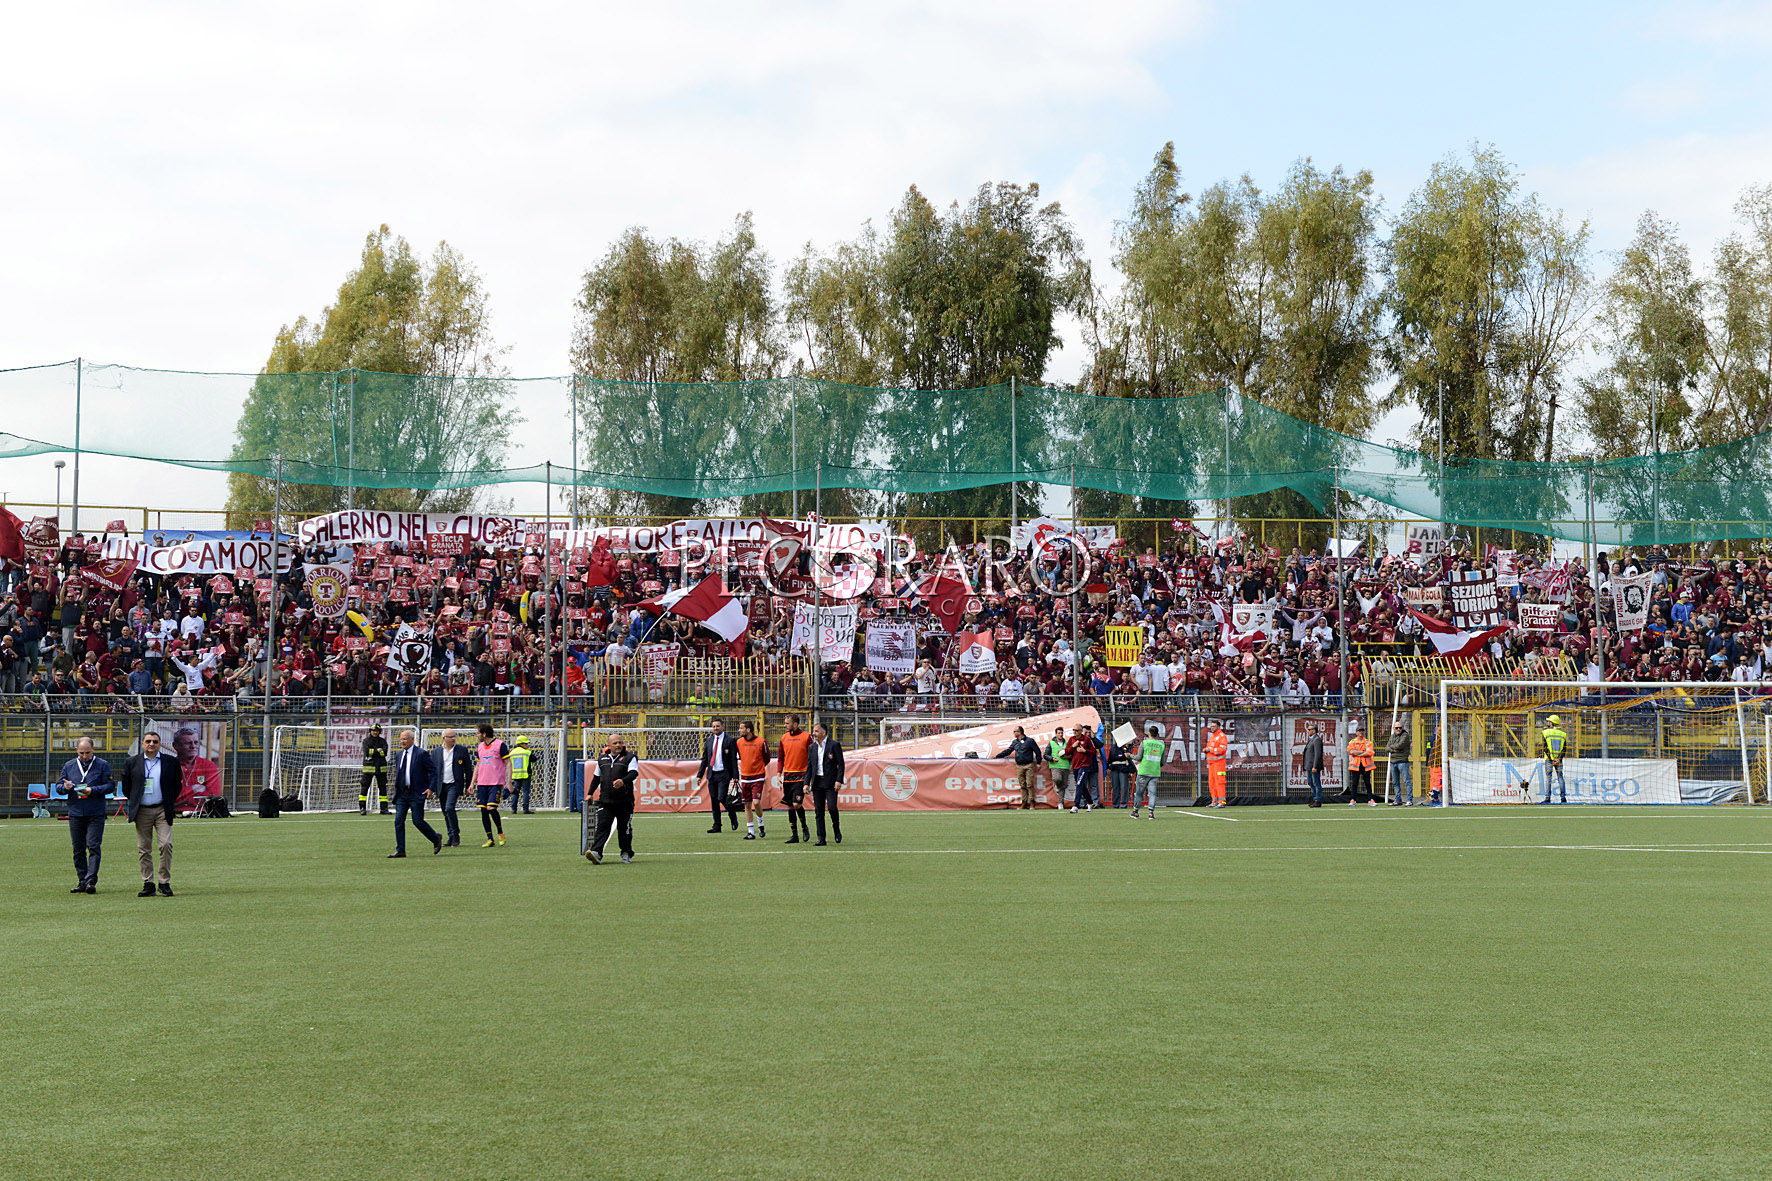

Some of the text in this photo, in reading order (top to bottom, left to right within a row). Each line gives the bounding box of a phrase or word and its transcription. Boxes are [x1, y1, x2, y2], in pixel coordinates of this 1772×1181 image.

[301, 511, 392, 546] SALERNO
[608, 521, 687, 552] FIORE
[105, 539, 291, 572] UNICO AMORE
[740, 570, 770, 578] RANATA
[1180, 568, 1195, 578] SA
[791, 580, 814, 590] FINO
[1451, 582, 1497, 599] SEZIONE
[1425, 590, 1442, 601] SOLA
[1453, 595, 1498, 613] TORINO
[1105, 630, 1140, 646] VIVO X
[1106, 647, 1140, 662] AMARTI
[944, 774, 1046, 795] expet
[1492, 787, 1520, 797] Italia
[640, 795, 702, 805] somma
